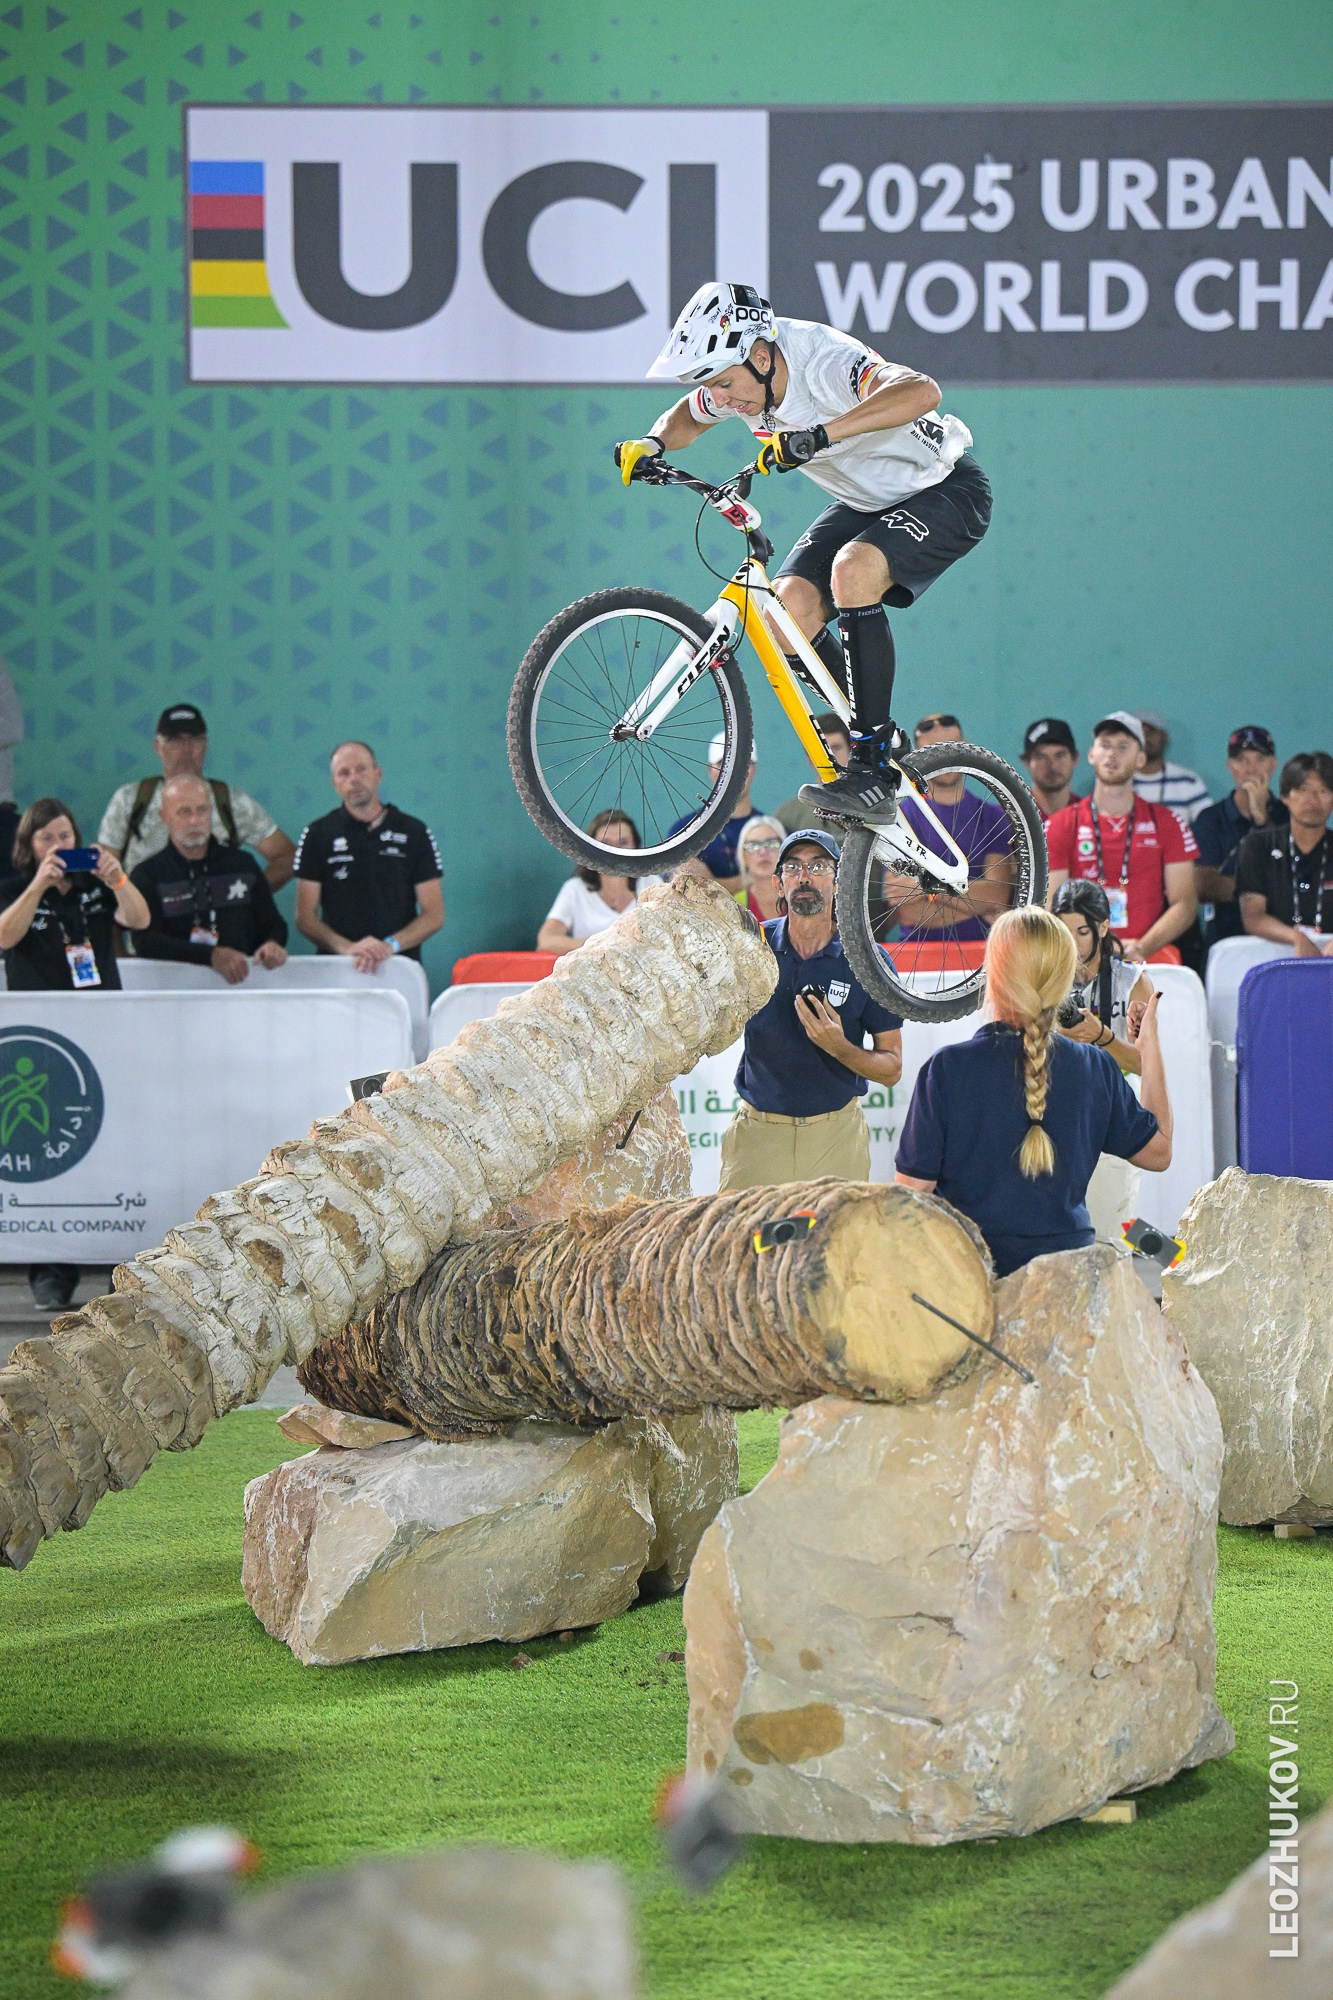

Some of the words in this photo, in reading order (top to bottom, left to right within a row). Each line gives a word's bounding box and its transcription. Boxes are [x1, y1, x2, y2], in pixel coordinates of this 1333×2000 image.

[817, 162, 1015, 233] 2025
[1040, 158, 1333, 231] URBAN
[292, 159, 717, 331] UCI
[815, 260, 1149, 333] WORLD
[677, 625, 731, 700] CLEAN
[61, 1219, 147, 1233] COMPANY
